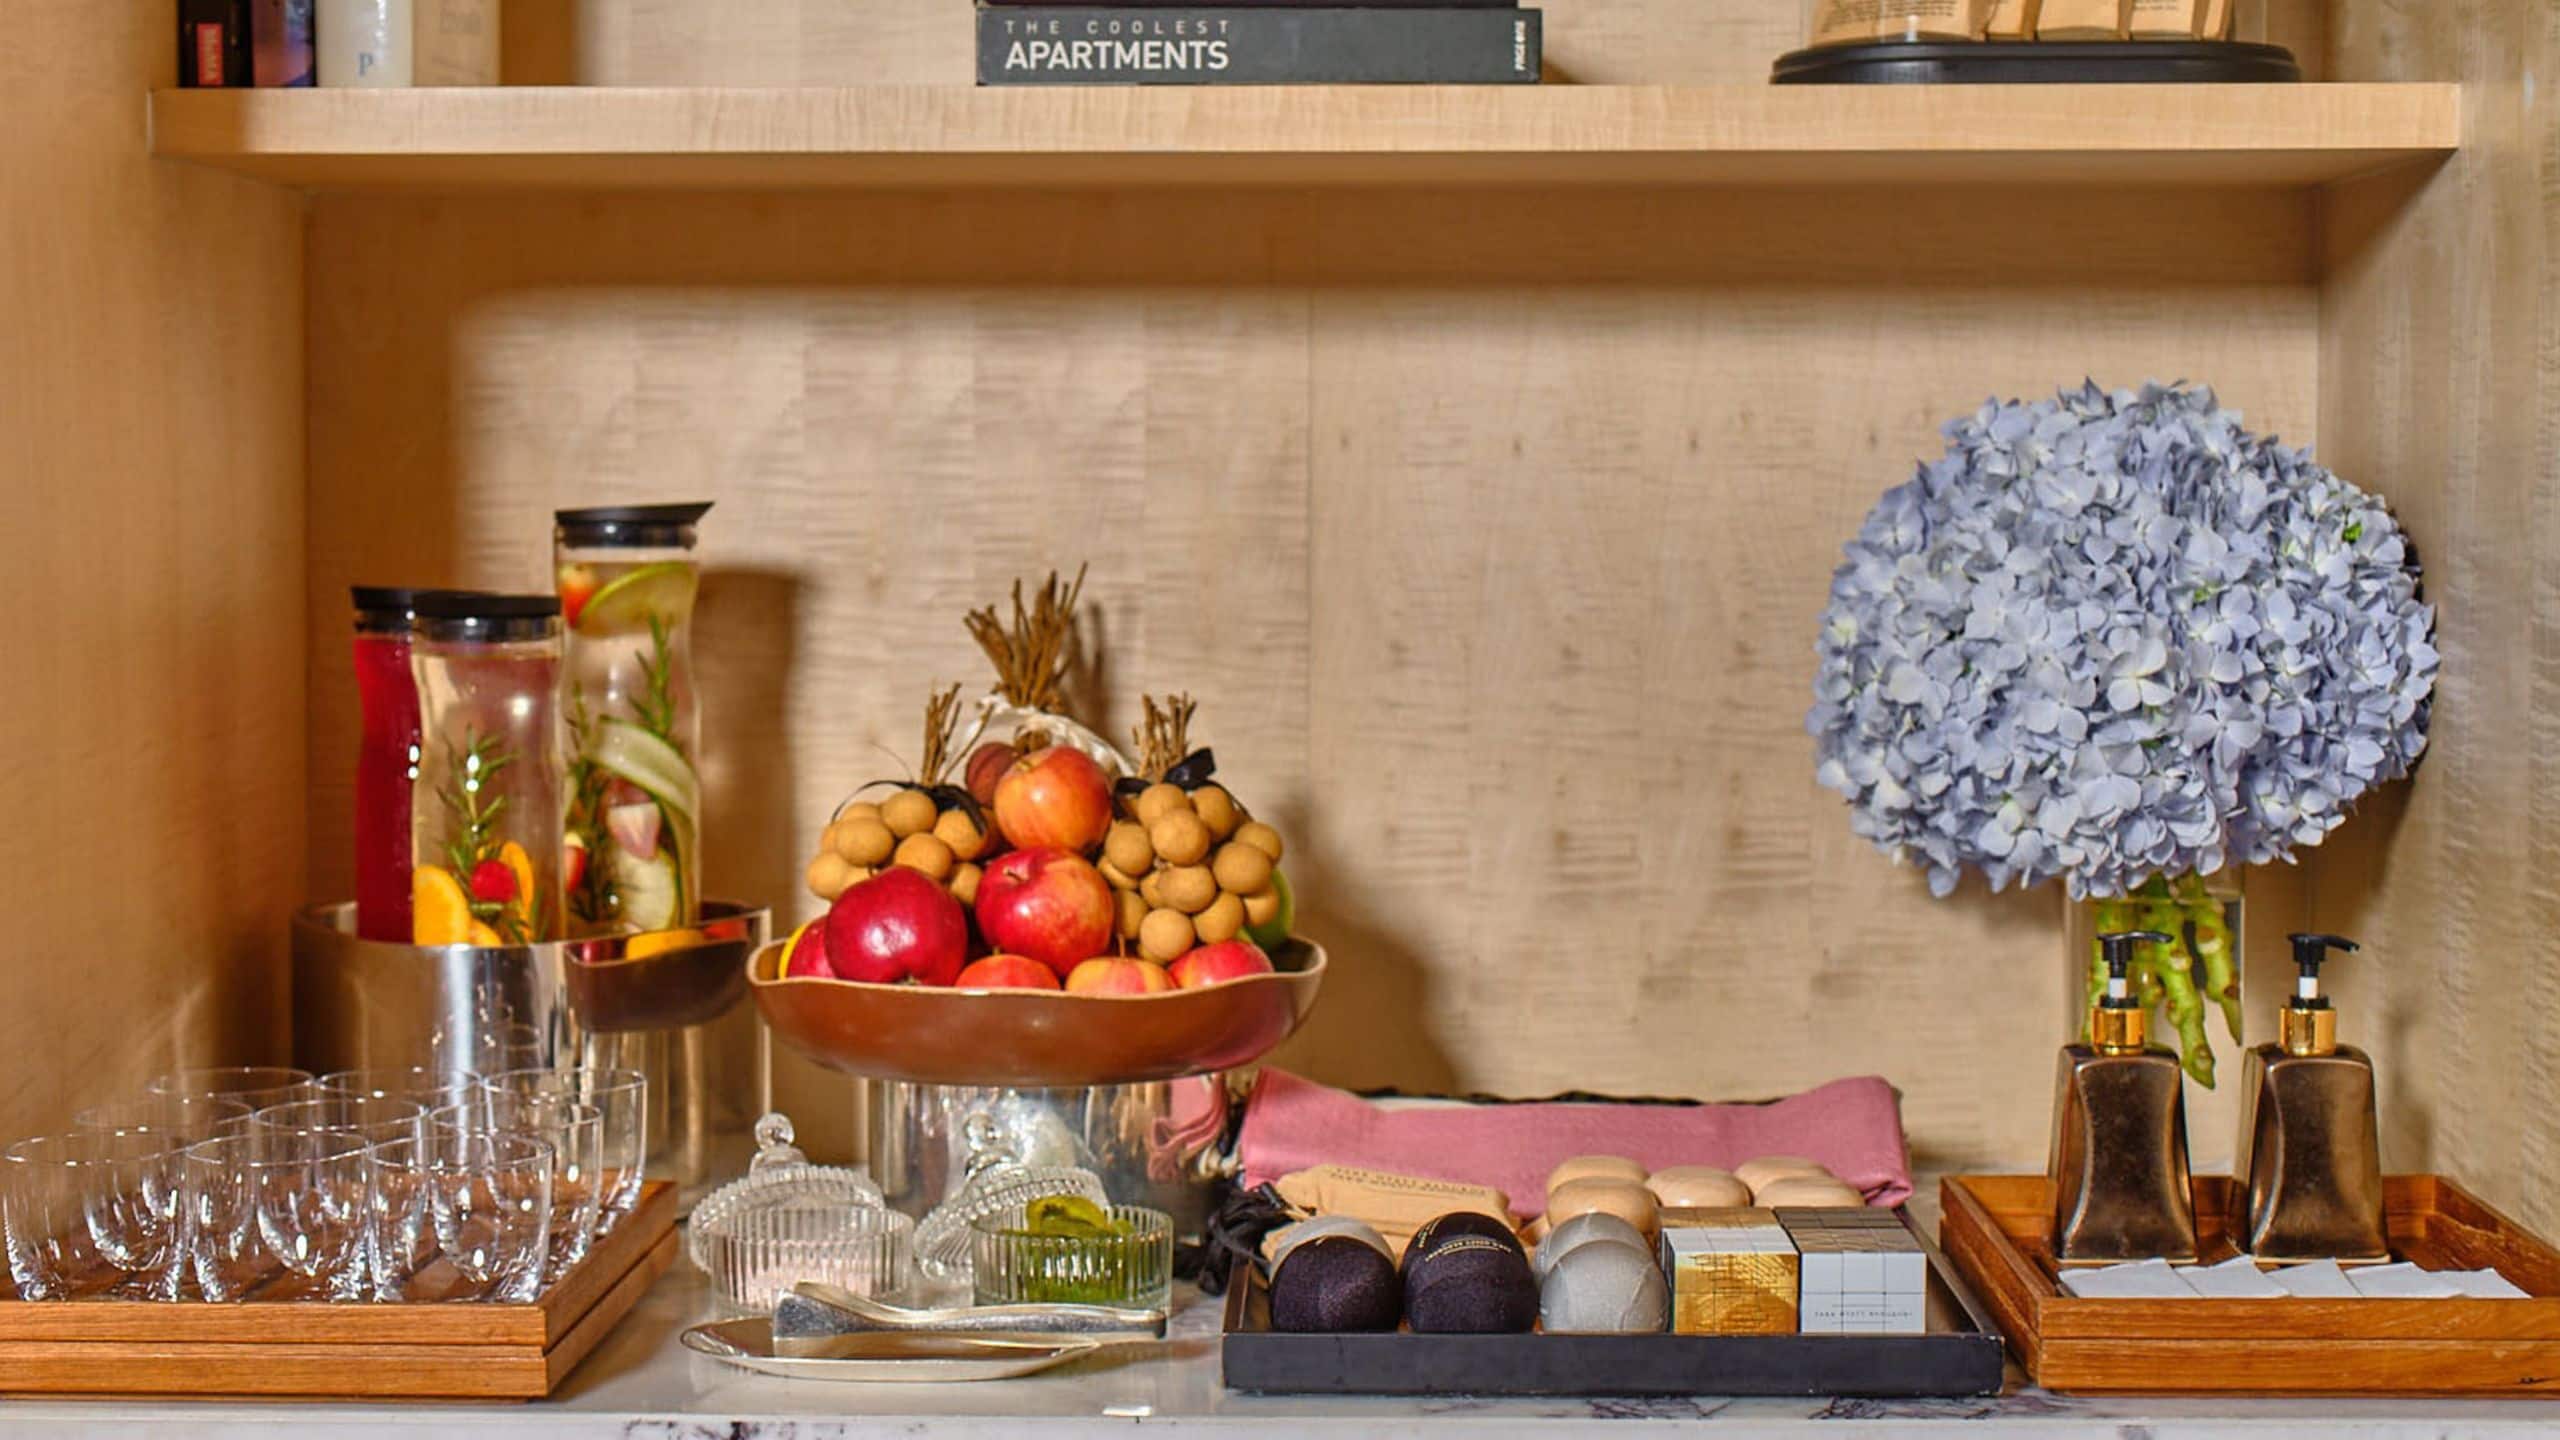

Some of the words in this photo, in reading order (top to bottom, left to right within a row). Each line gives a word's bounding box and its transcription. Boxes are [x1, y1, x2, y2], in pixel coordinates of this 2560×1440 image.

[1005, 20, 1060, 34] THE
[1087, 20, 1230, 34] COOLEST
[1004, 40, 1230, 70] APARTMENTS
